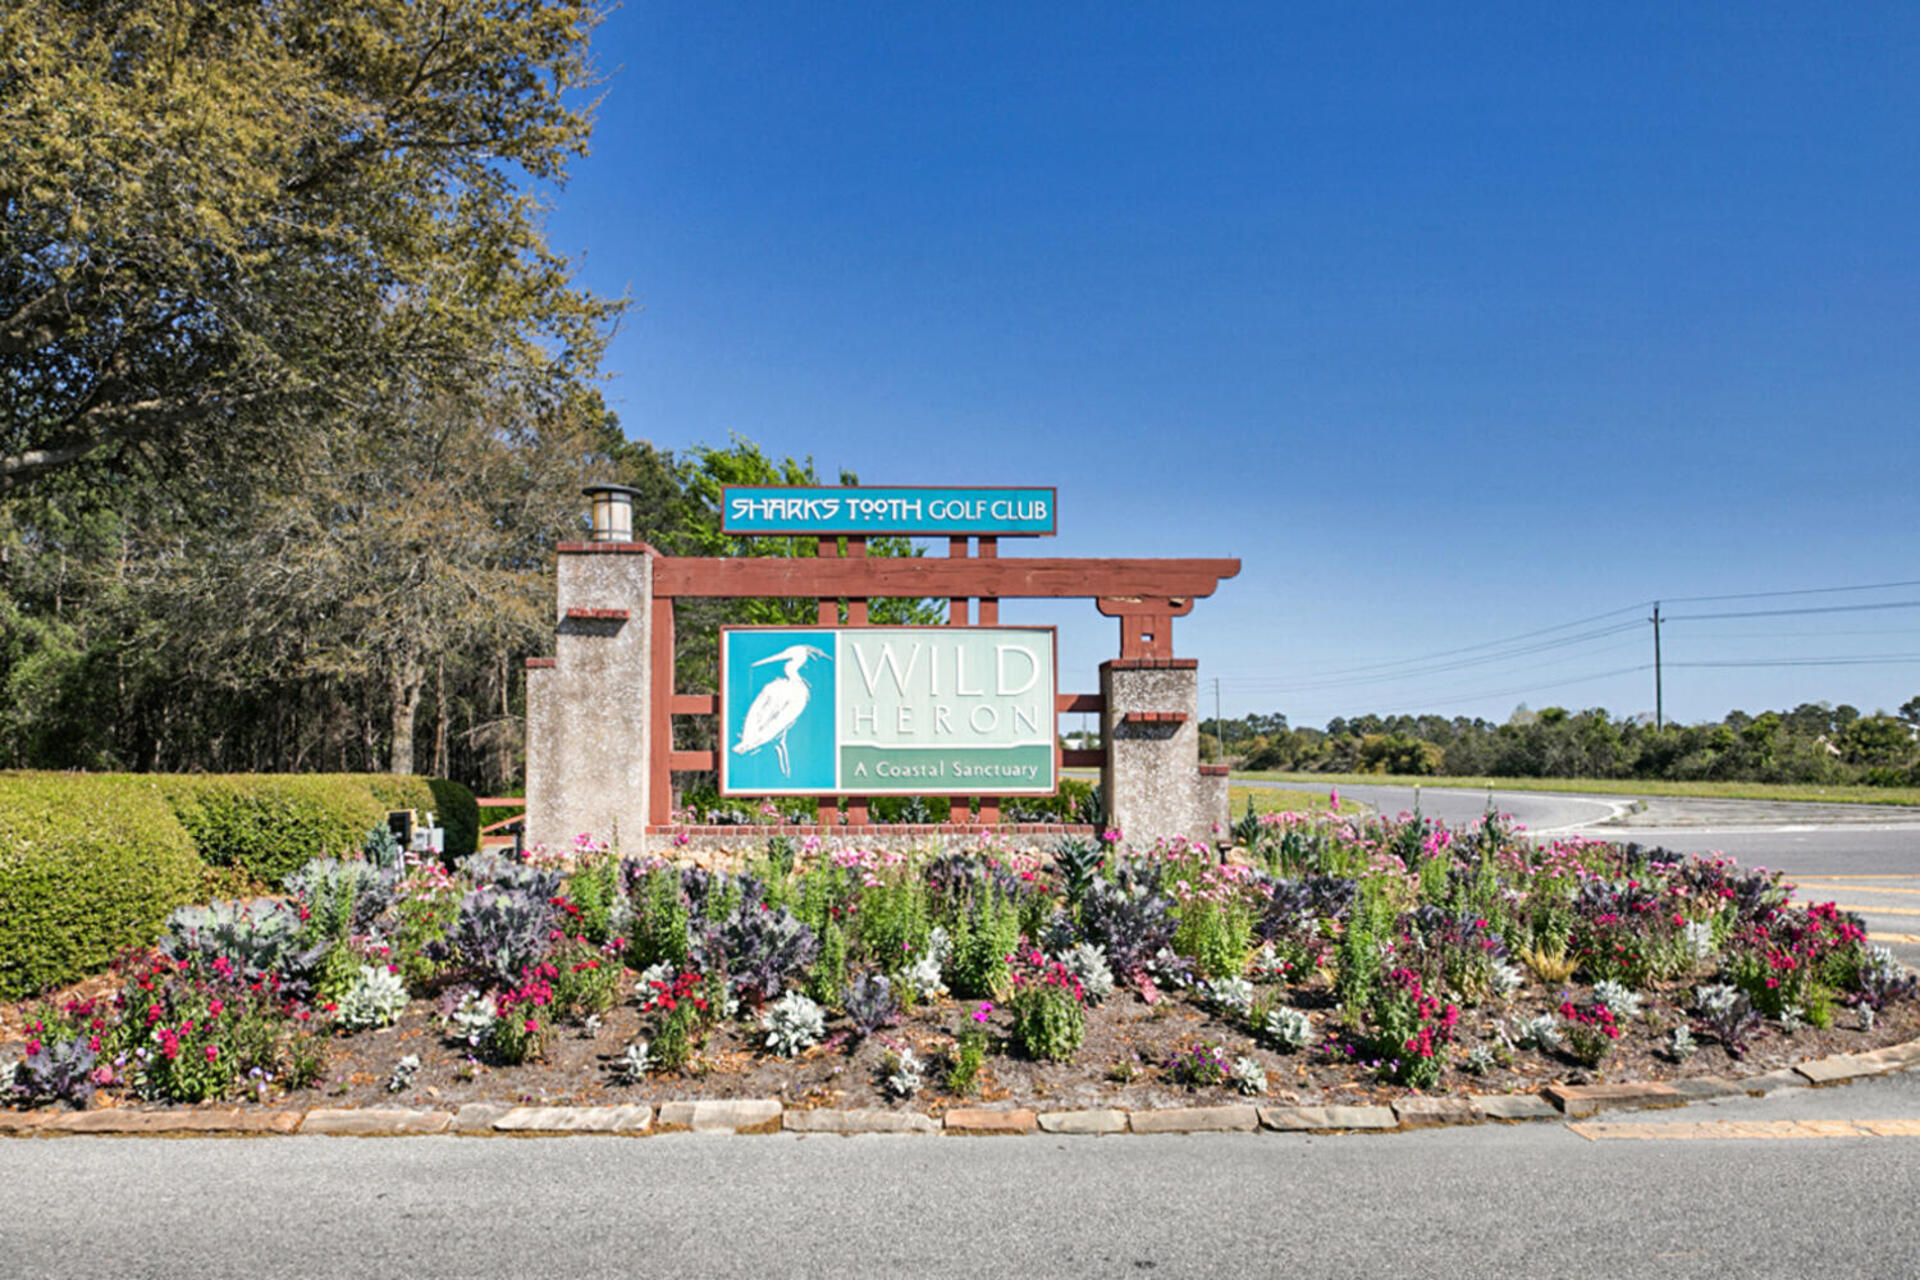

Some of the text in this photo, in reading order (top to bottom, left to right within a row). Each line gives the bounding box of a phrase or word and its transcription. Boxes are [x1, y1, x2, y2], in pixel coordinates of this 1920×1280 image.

[846, 498, 922, 521] TOOTH
[928, 500, 987, 520] GOLF
[991, 500, 1047, 520] CLUB
[851, 641, 1040, 697] WILD
[853, 703, 1038, 734] HERON
[854, 760, 1038, 780] A Coastal Sanctuary
